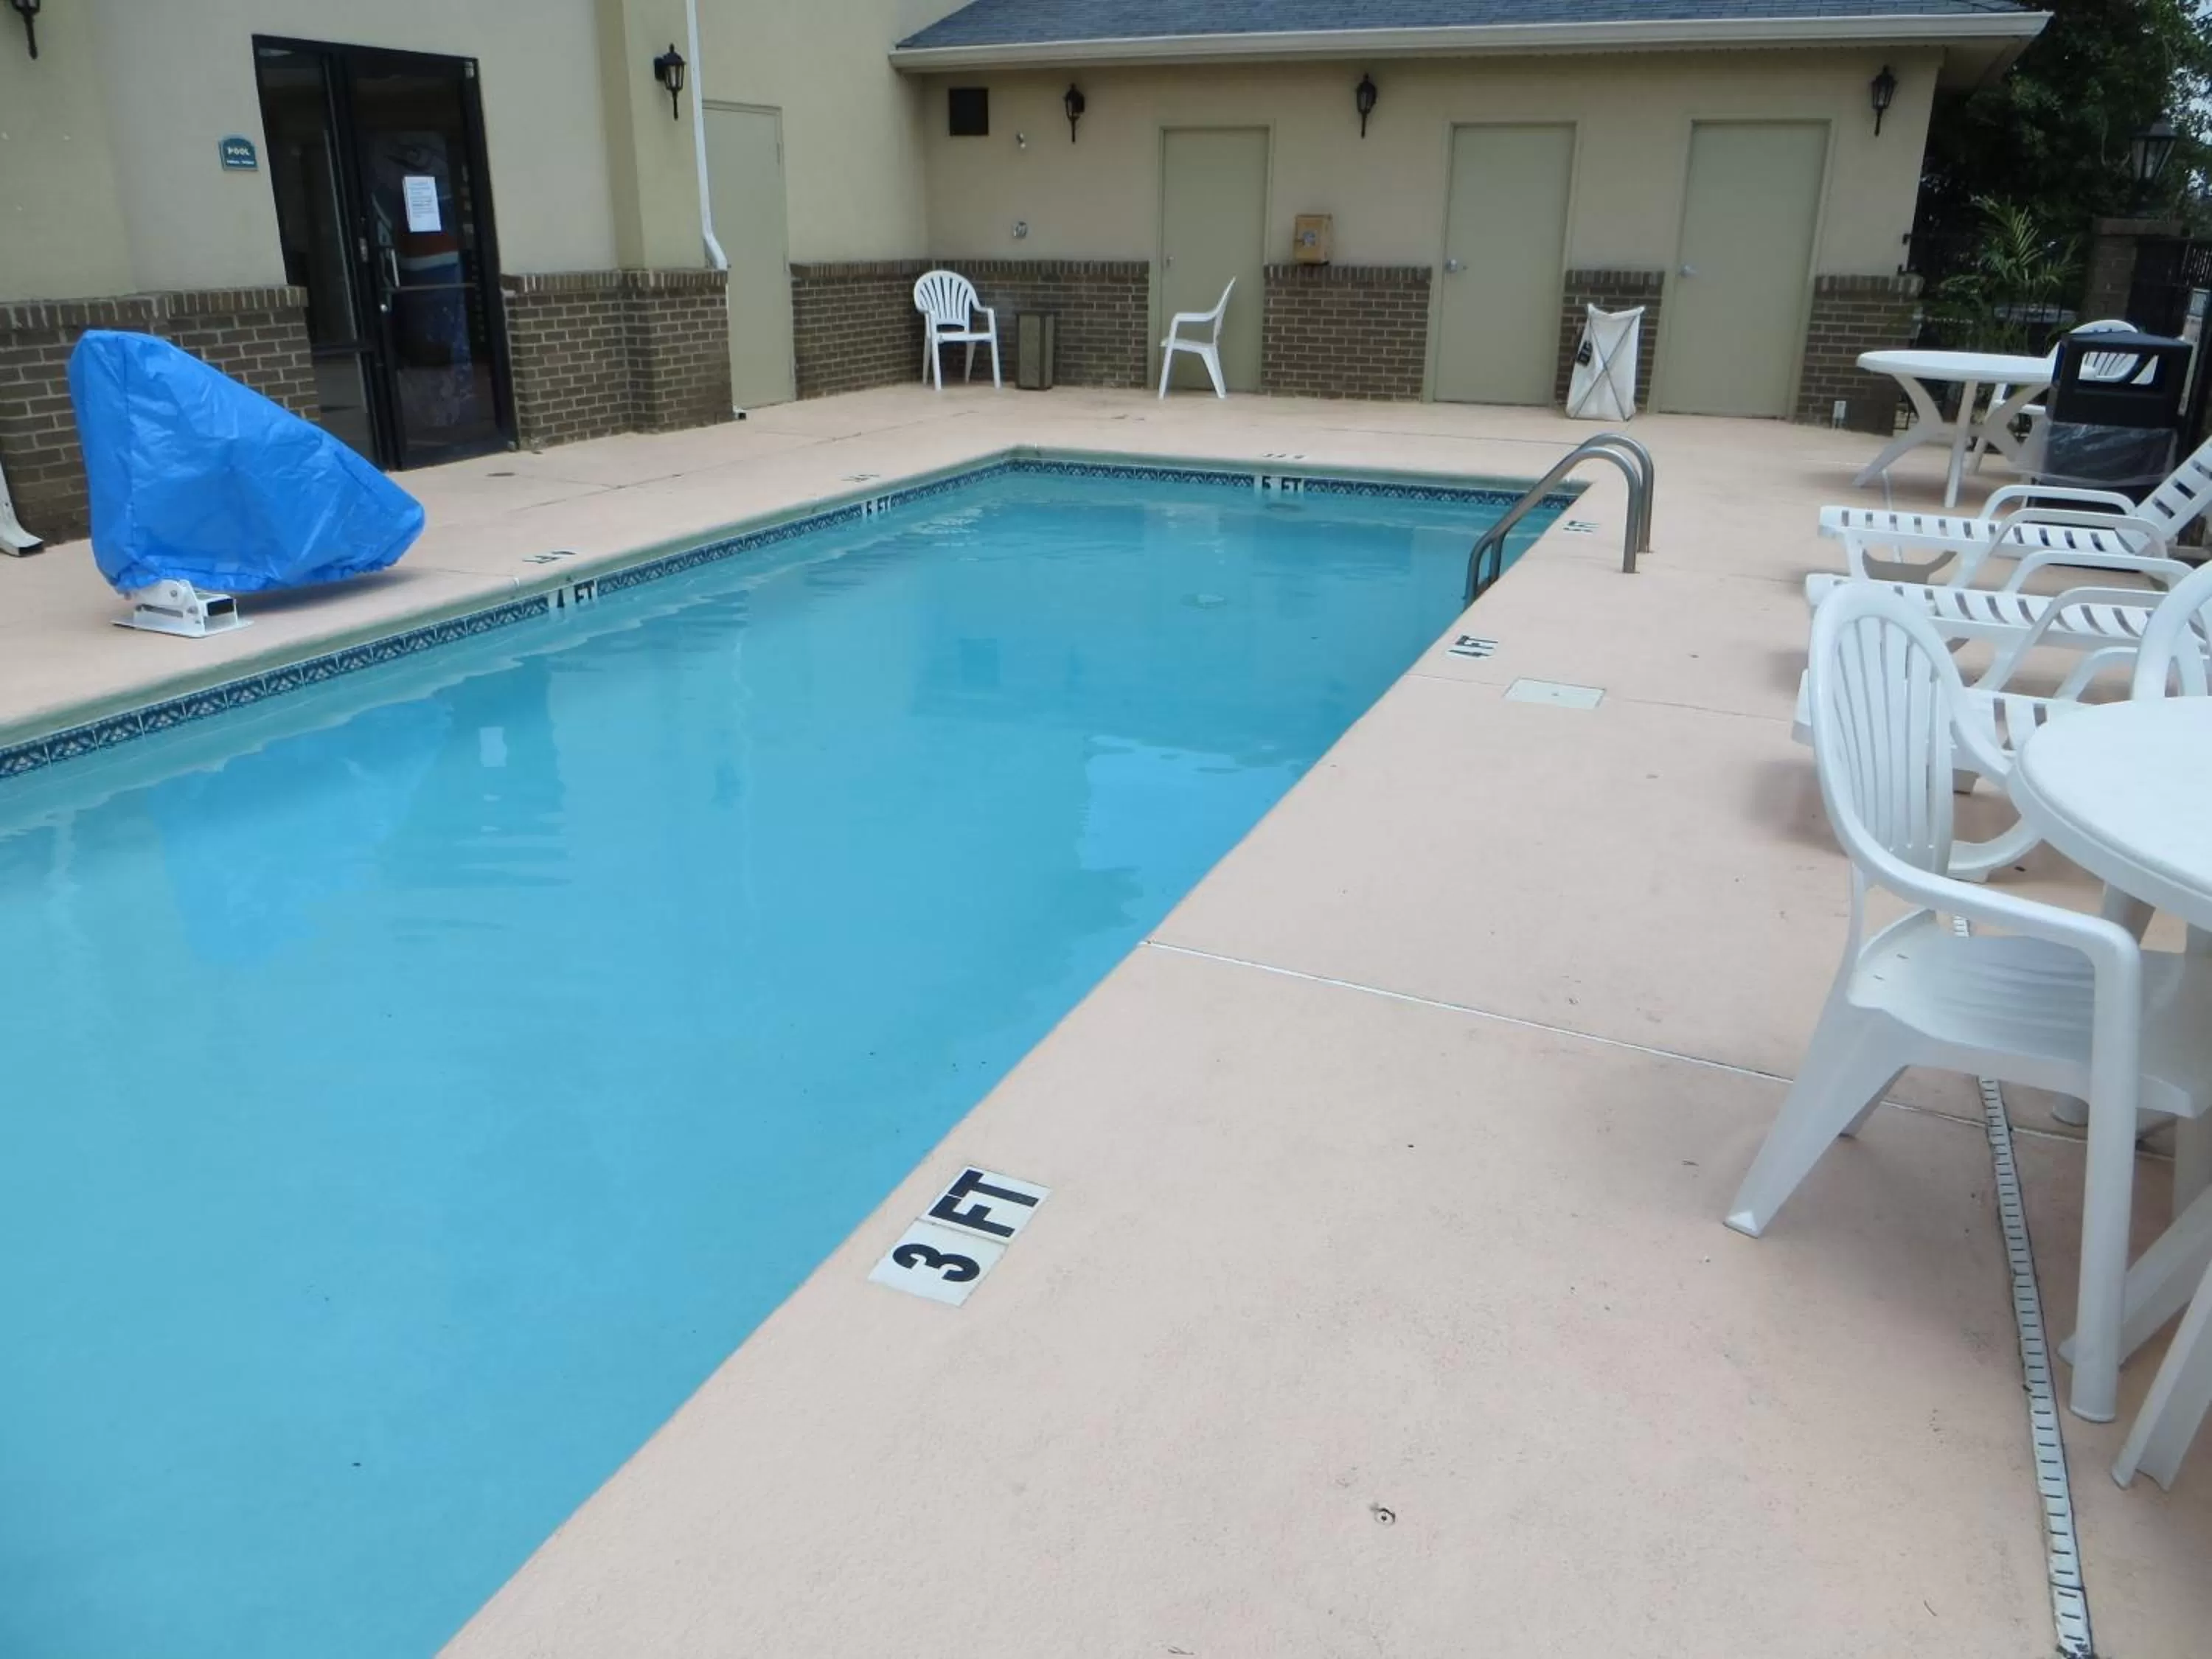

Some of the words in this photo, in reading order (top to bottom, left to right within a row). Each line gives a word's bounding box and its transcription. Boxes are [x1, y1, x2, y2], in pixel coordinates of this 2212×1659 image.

[574, 580, 595, 604] FT
[928, 1169, 1040, 1239] FT
[892, 1243, 981, 1283] 3
